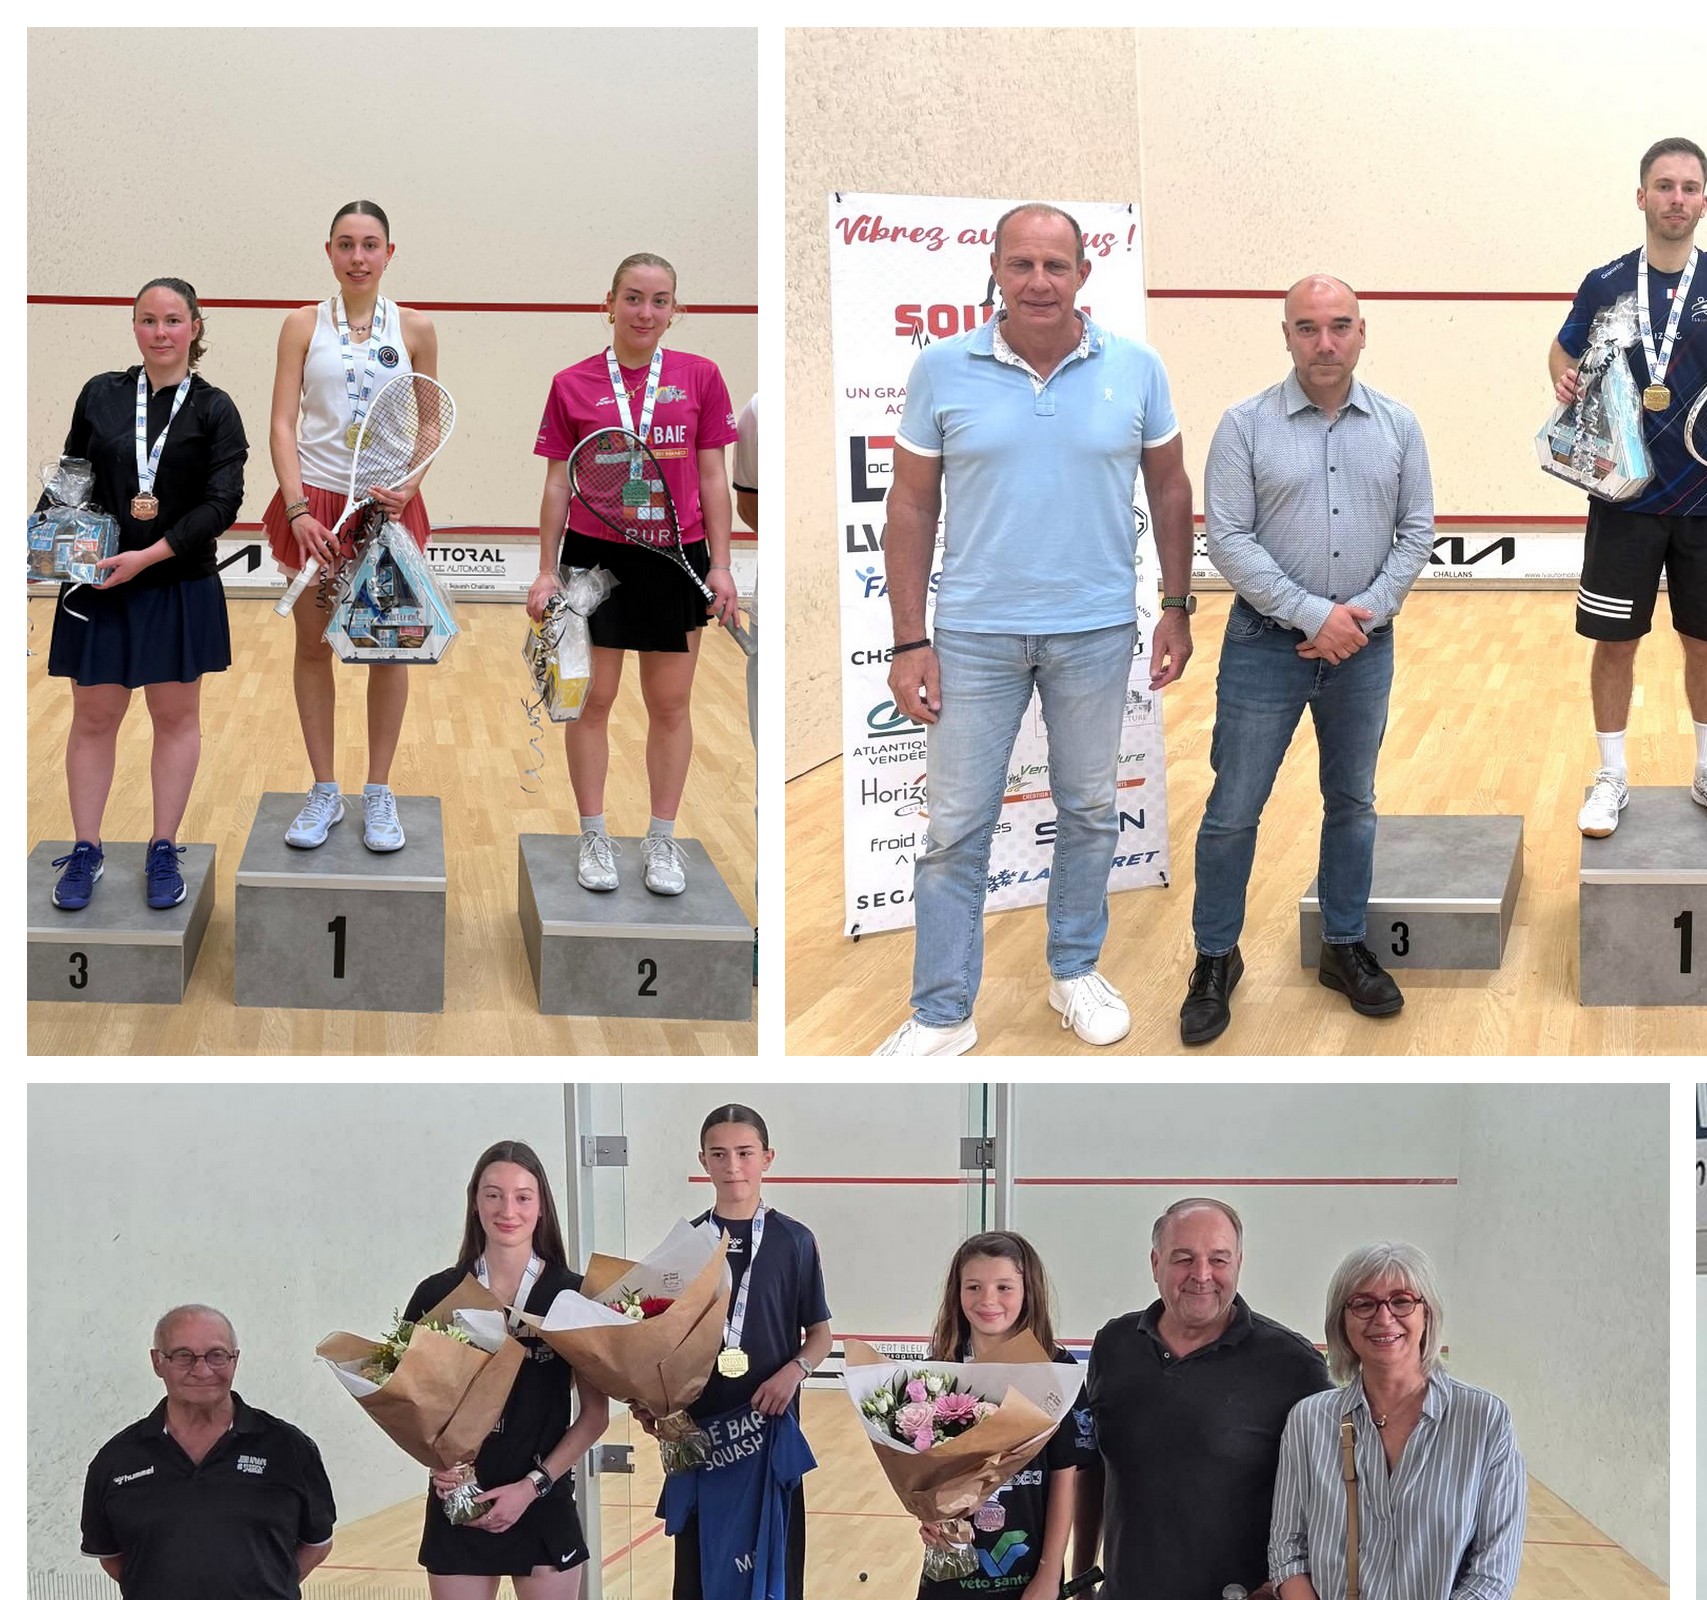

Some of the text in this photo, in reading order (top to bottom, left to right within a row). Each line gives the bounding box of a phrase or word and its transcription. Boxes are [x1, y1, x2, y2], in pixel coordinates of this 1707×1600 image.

[835, 214, 950, 251] Vibrez
[957, 227, 996, 245] av
[846, 387, 906, 399] UN GRA
[427, 547, 505, 562] TTORAL
[1433, 570, 1473, 578] CHALLANS
[869, 751, 927, 766] VENDÉE
[1020, 764, 1048, 776] Ven
[871, 833, 915, 852] froid
[327, 915, 347, 978] 1
[1391, 921, 1410, 957] 3
[1673, 910, 1694, 975] 1
[69, 952, 89, 989] 3
[637, 958, 658, 997] 2
[726, 1409, 767, 1440] BAR
[959, 1575, 990, 1590] véto
